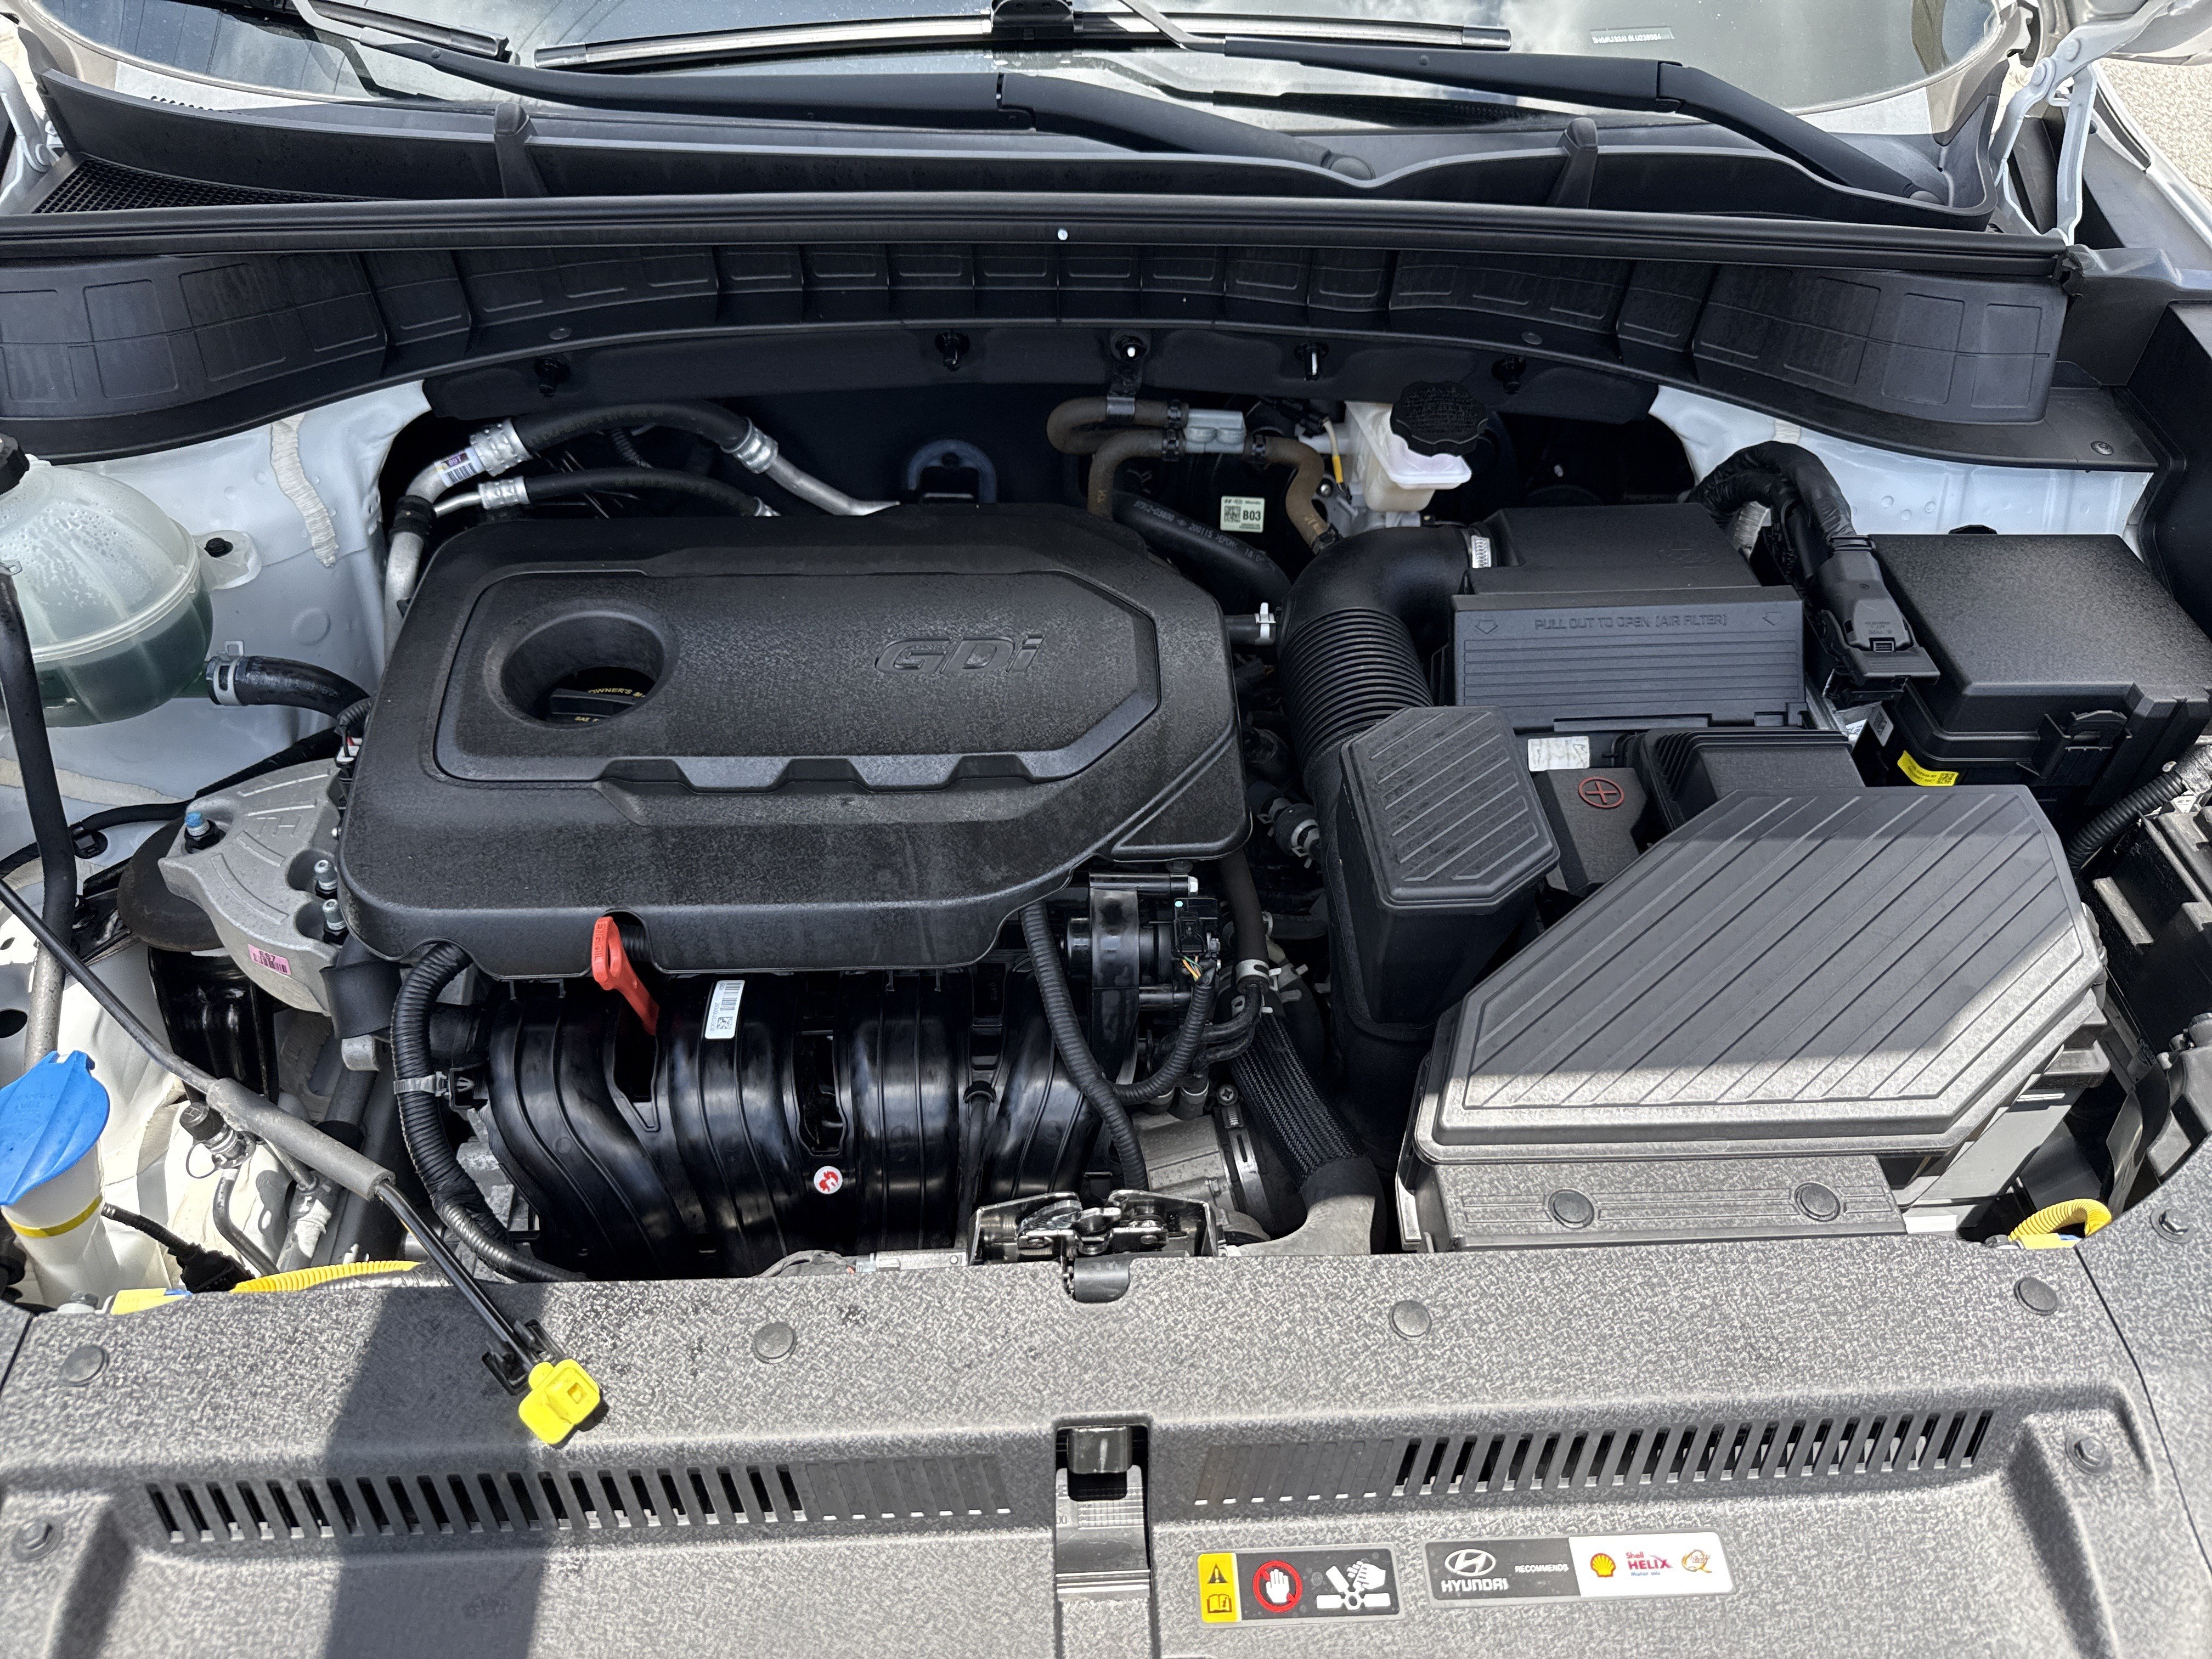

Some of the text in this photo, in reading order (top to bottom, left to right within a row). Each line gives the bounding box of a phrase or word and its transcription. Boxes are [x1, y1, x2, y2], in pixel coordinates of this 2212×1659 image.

[1243, 510, 1261, 521] B03
[1536, 619, 1566, 630] PULL
[1569, 618, 1594, 629] OUT
[1597, 617, 1613, 628] TO
[1617, 616, 1650, 628] OPEN
[874, 633, 1046, 674] GDi
[594, 923, 606, 962] ENG OIL
[259, 950, 276, 962] ES7
[1626, 1551, 1645, 1560] Shell
[1515, 1563, 1570, 1573] RECOMMENDS
[1628, 1558, 1671, 1570] HELIX
[1441, 1578, 1509, 1593] HYUNDAI
